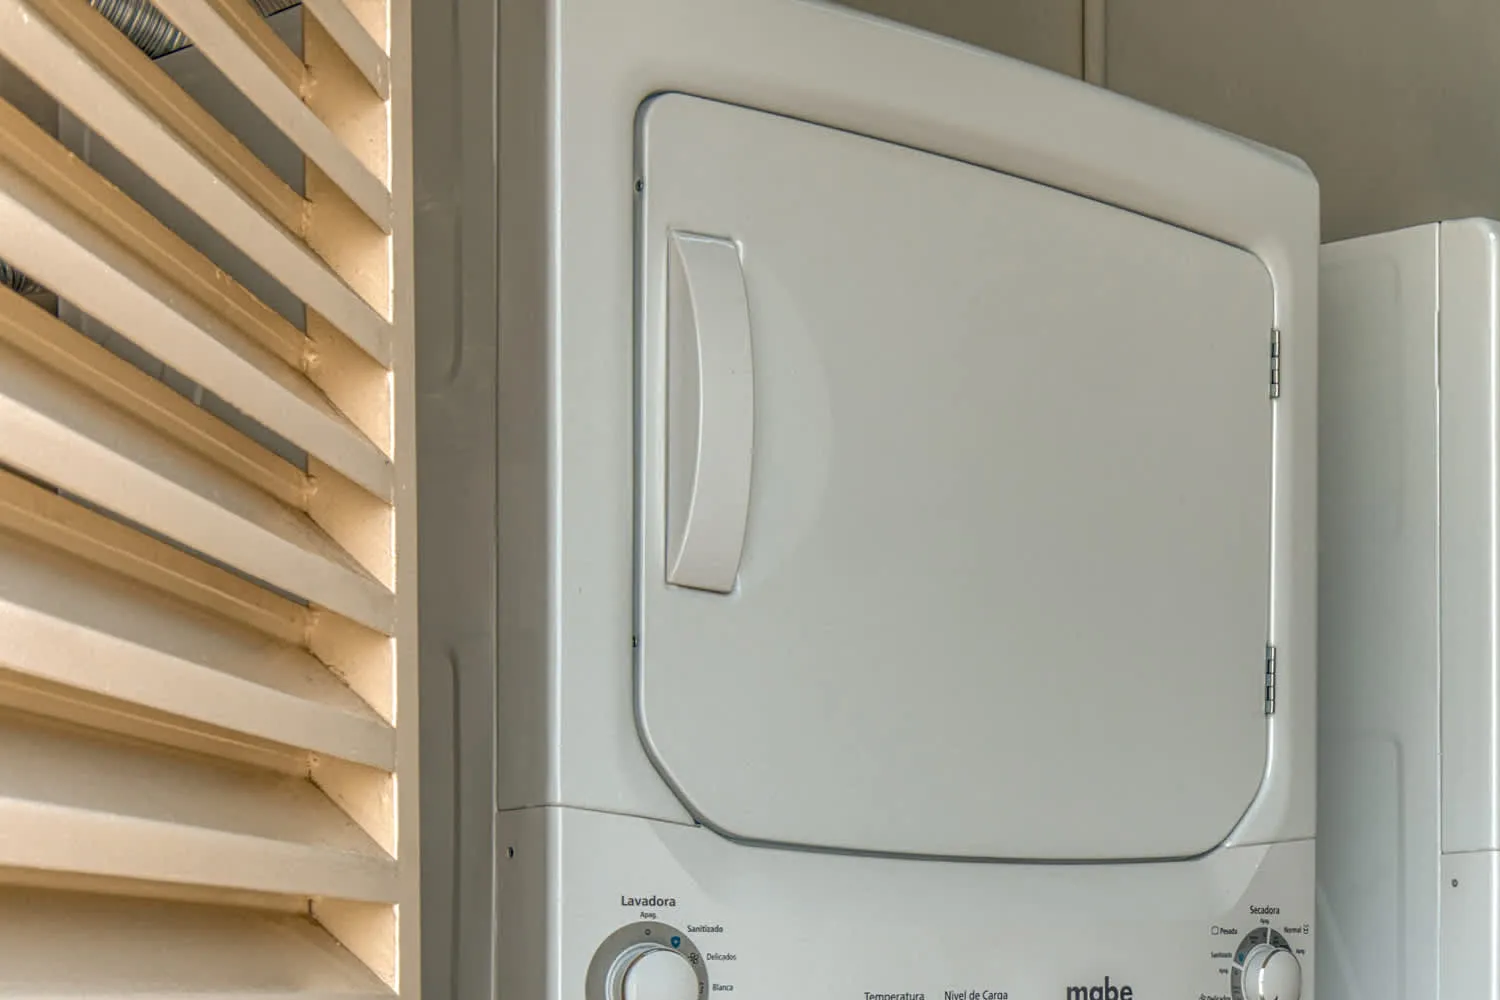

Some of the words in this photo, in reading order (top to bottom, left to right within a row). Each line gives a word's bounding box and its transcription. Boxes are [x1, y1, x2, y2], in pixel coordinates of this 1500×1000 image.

[621, 895, 676, 907] Lavadora
[1249, 905, 1280, 915] Secadora
[687, 924, 724, 933] Sanitizado
[706, 953, 737, 961] Delicados
[712, 984, 734, 992] Blanca
[944, 991, 966, 1000] Nivel
[968, 990, 981, 1000] de
